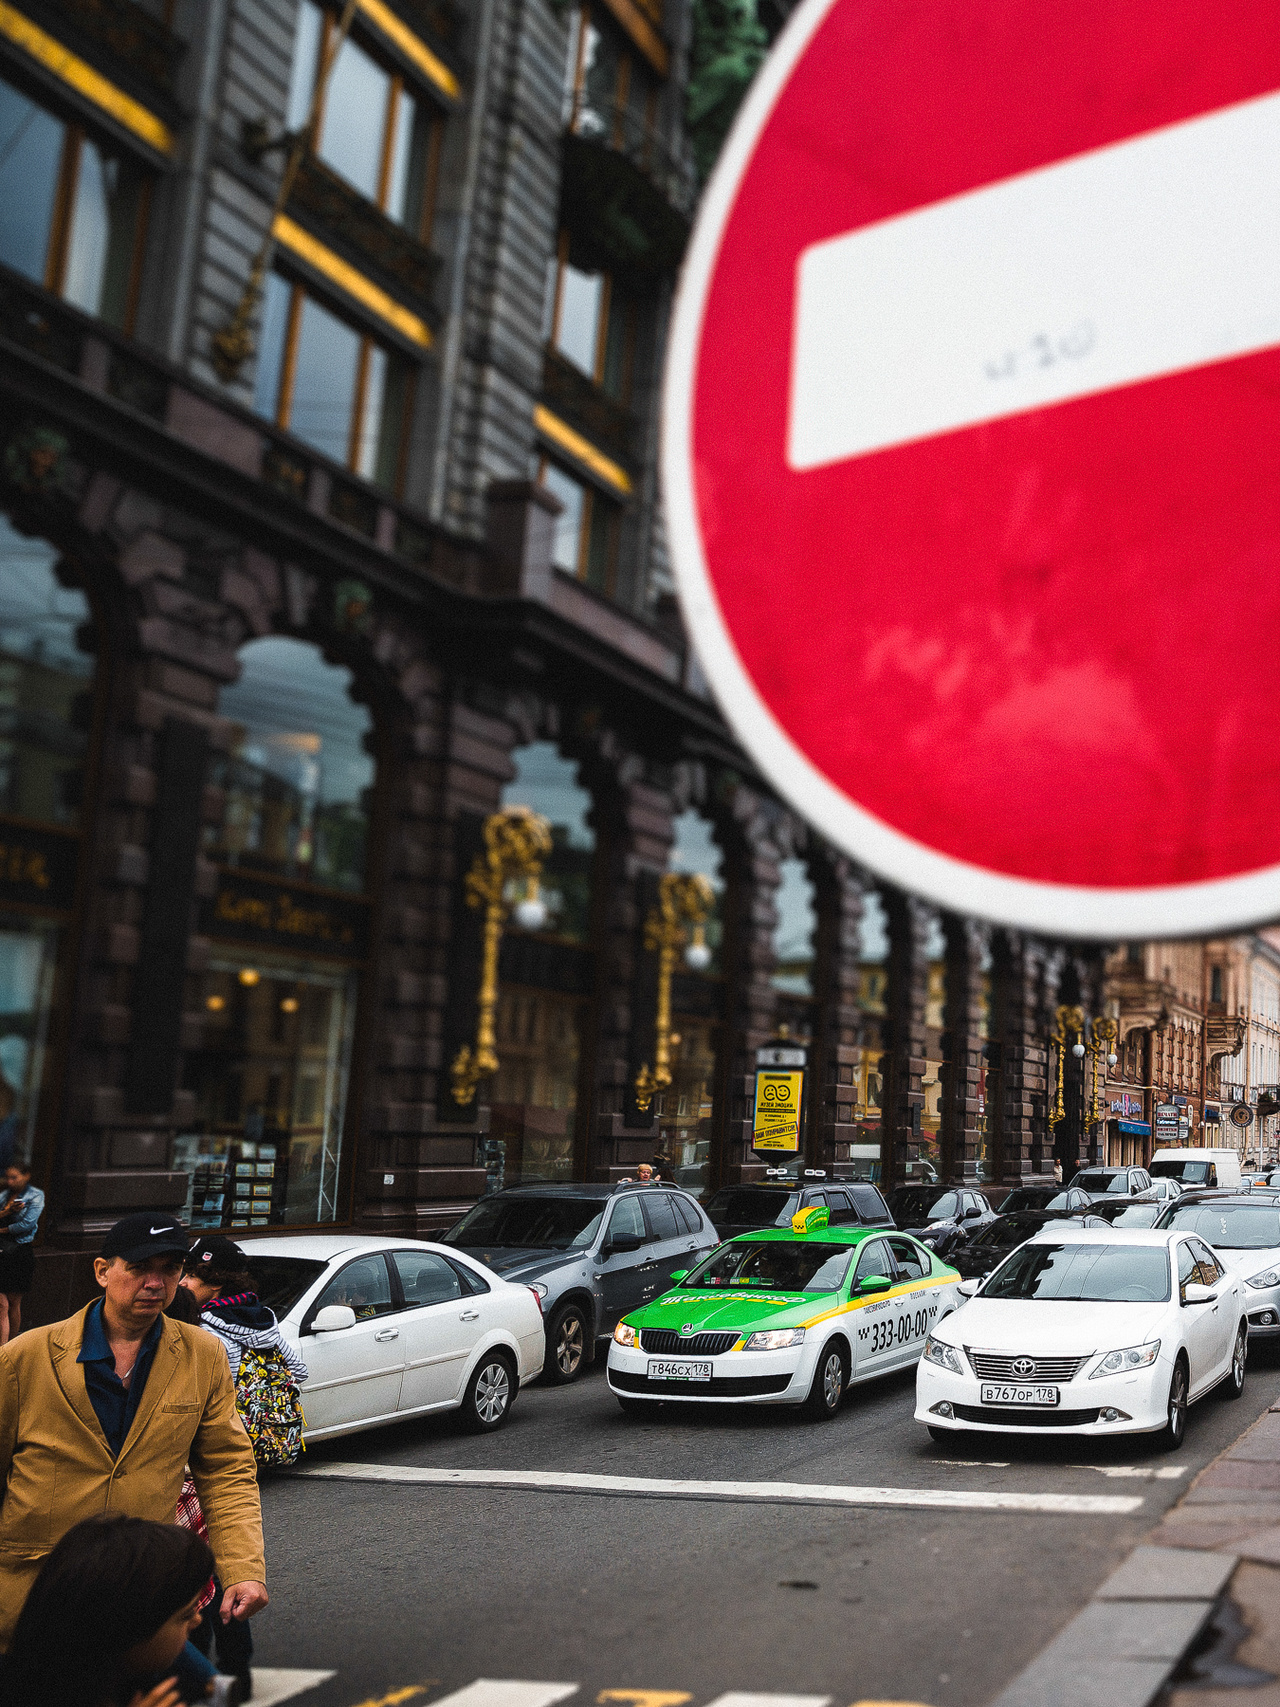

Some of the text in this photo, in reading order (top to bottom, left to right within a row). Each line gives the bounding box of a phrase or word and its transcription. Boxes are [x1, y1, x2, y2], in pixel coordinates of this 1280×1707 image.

[871, 1308, 928, 1353] 333-00-00
[652, 1363, 709, 1375] Т846СХ 178
[986, 1387, 1053, 1401] В767ОР 178
